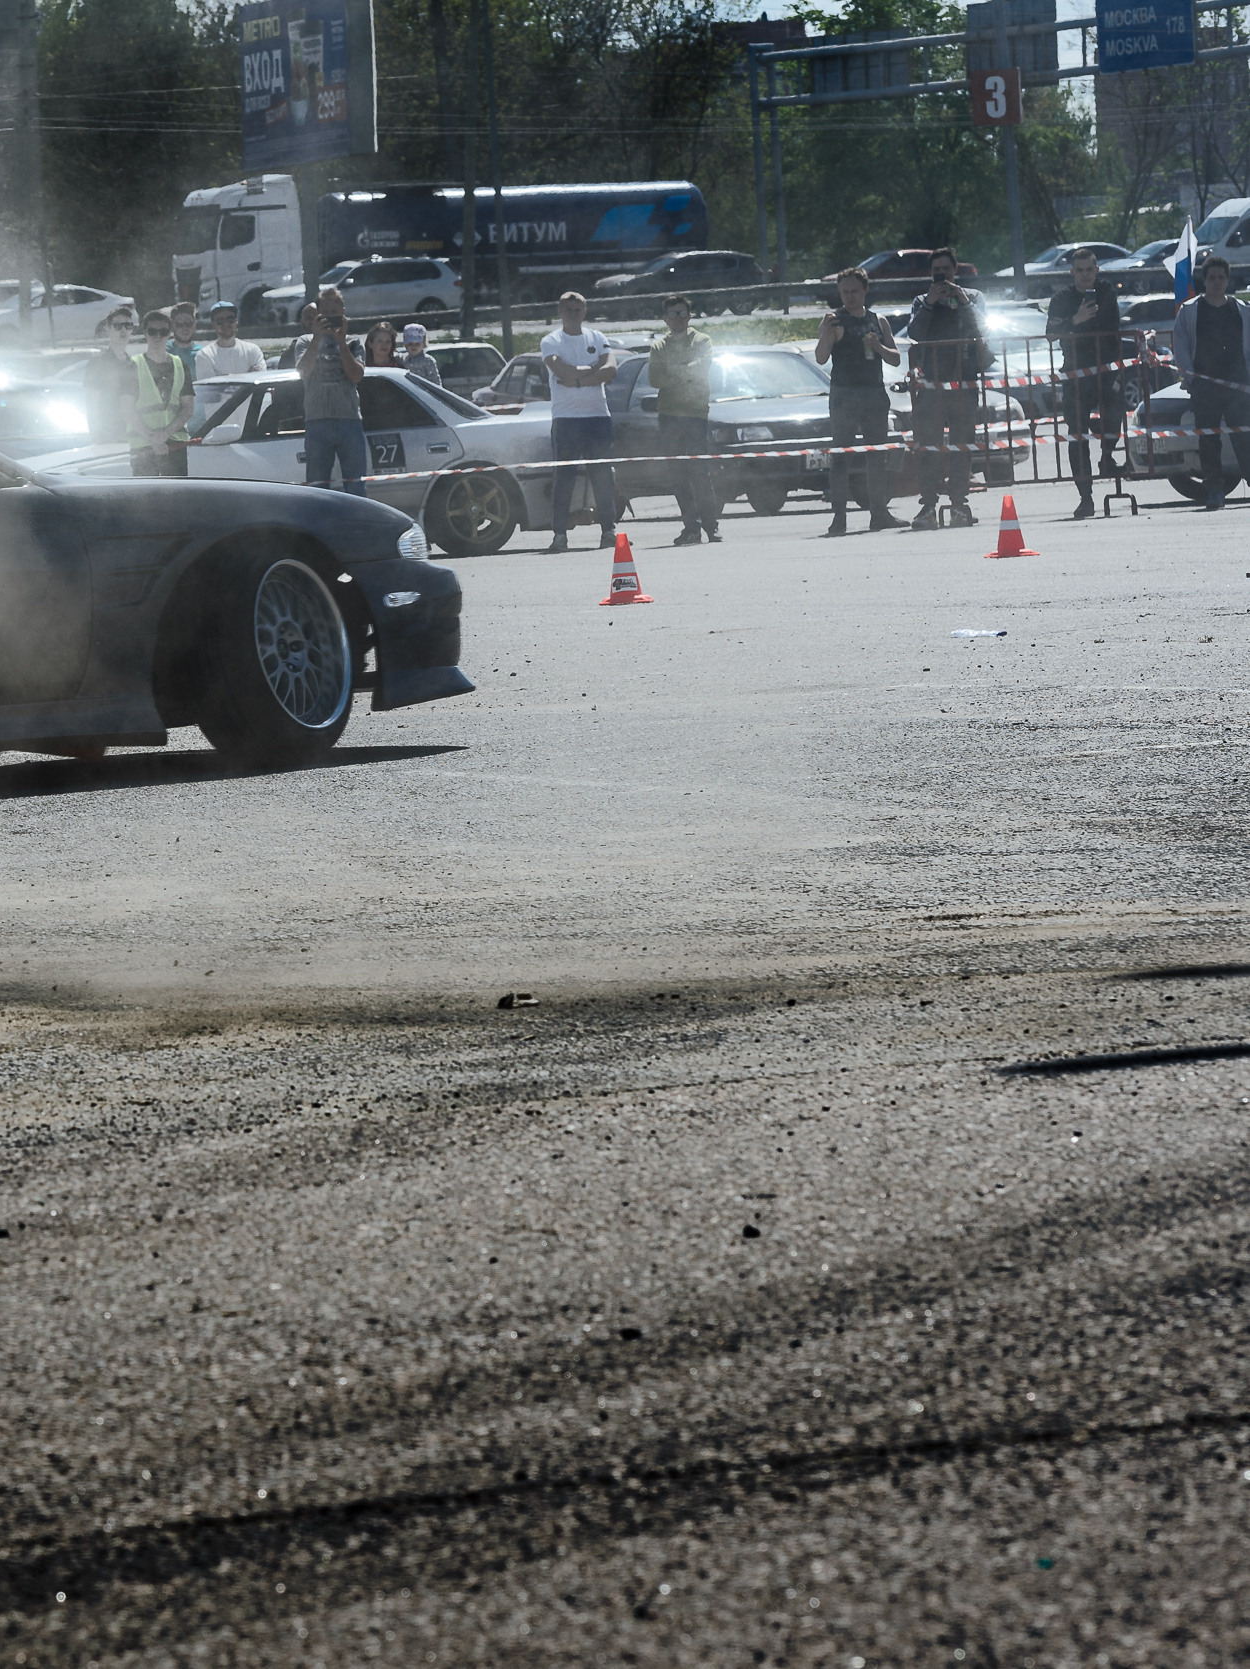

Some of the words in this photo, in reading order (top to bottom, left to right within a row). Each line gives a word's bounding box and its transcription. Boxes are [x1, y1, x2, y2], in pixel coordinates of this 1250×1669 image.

[1104, 6, 1157, 28] МОСКВА
[1165, 17, 1185, 35] 178
[243, 16, 280, 43] METRO
[1105, 35, 1159, 57] MOSKVA
[244, 50, 284, 93] ВХОД
[985, 76, 1007, 118] 3
[376, 444, 398, 463] 27
